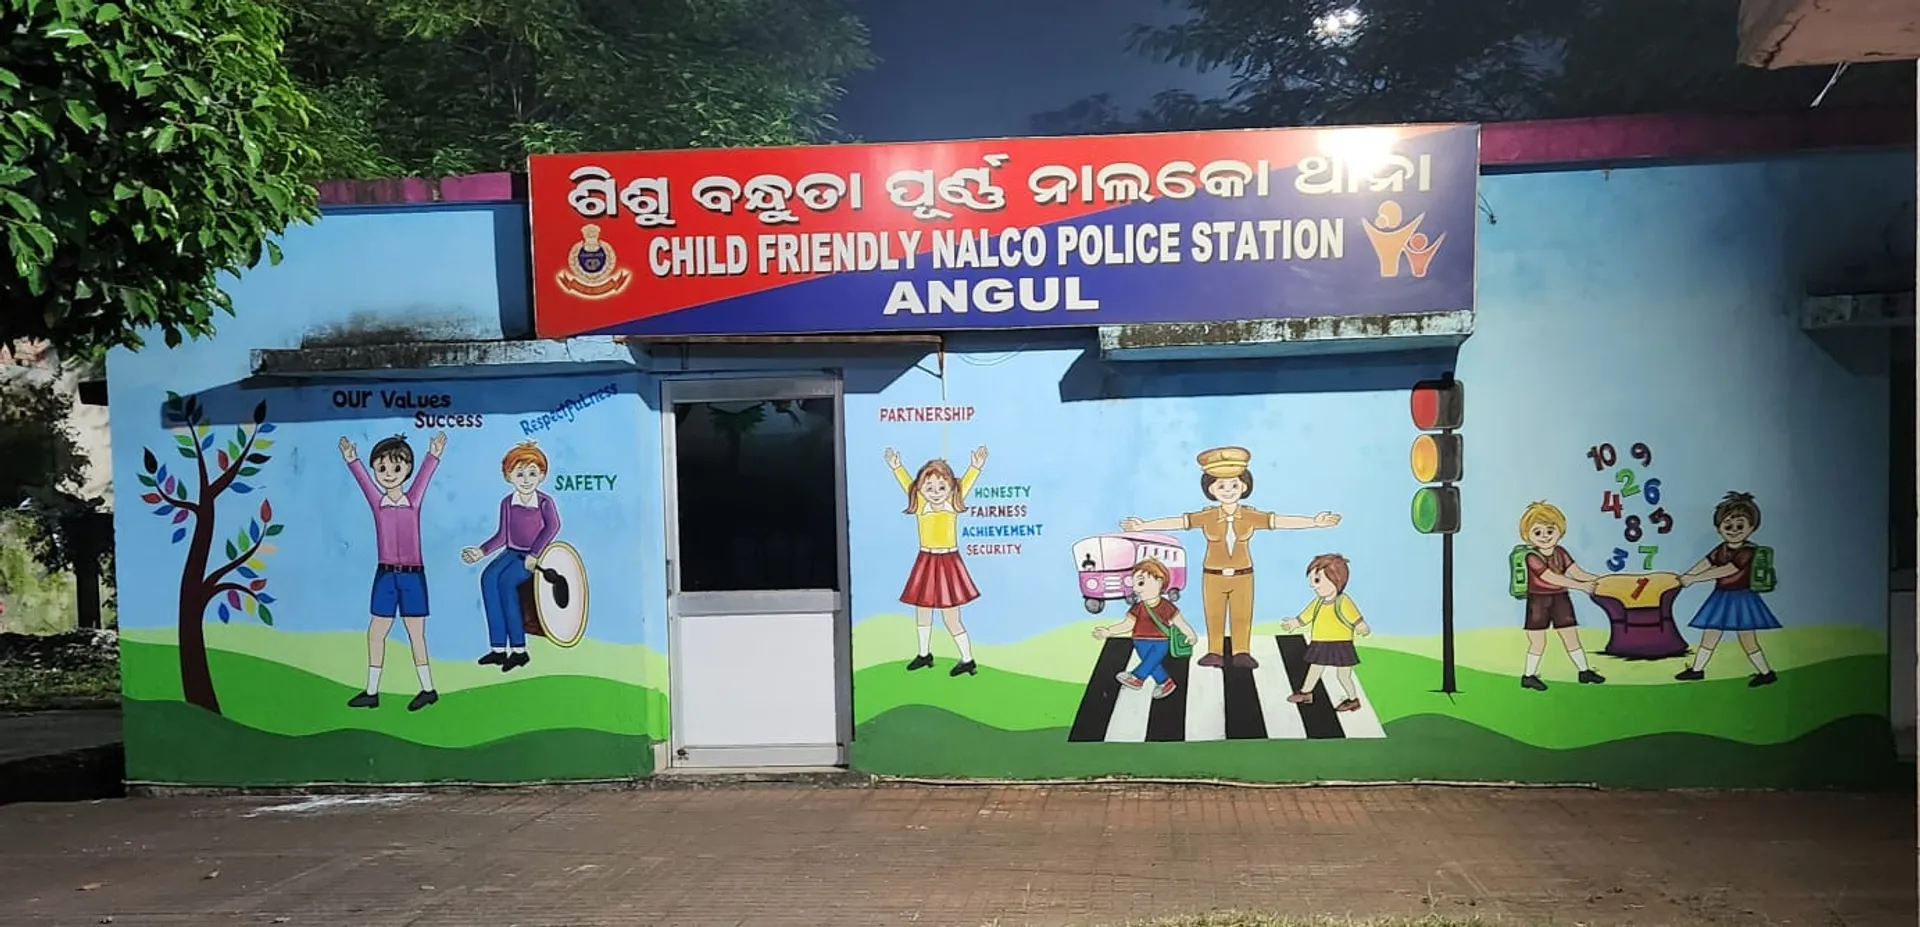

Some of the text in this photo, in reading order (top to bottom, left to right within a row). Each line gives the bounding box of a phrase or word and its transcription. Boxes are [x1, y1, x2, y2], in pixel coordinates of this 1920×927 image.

[568, 166, 674, 226] ଶିଶୁ
[1028, 155, 1270, 204] ନାଲକୋ
[648, 218, 1345, 276] CHILD FRIENDLY NALCO POLICE STATION
[882, 276, 1099, 315] ANGUL
[414, 411, 483, 429] Success
[880, 406, 975, 422] PARTNERSHIP
[1586, 443, 1617, 471] 10
[1630, 442, 1652, 467] 9
[555, 474, 617, 491] SAFETY
[974, 485, 1032, 499] HONESTY
[1616, 468, 1641, 498] 2
[1644, 478, 1662, 505] 6
[970, 505, 1028, 518] FAIRNESS
[1600, 490, 1623, 519] 4
[962, 524, 1043, 537] ACHIEVEMENT
[1624, 515, 1643, 542] 8
[1649, 507, 1673, 534] 5
[966, 544, 1022, 556] SECURITY
[1606, 547, 1629, 572] 3
[1638, 545, 1659, 570] 7
[1630, 577, 1650, 600] 1
